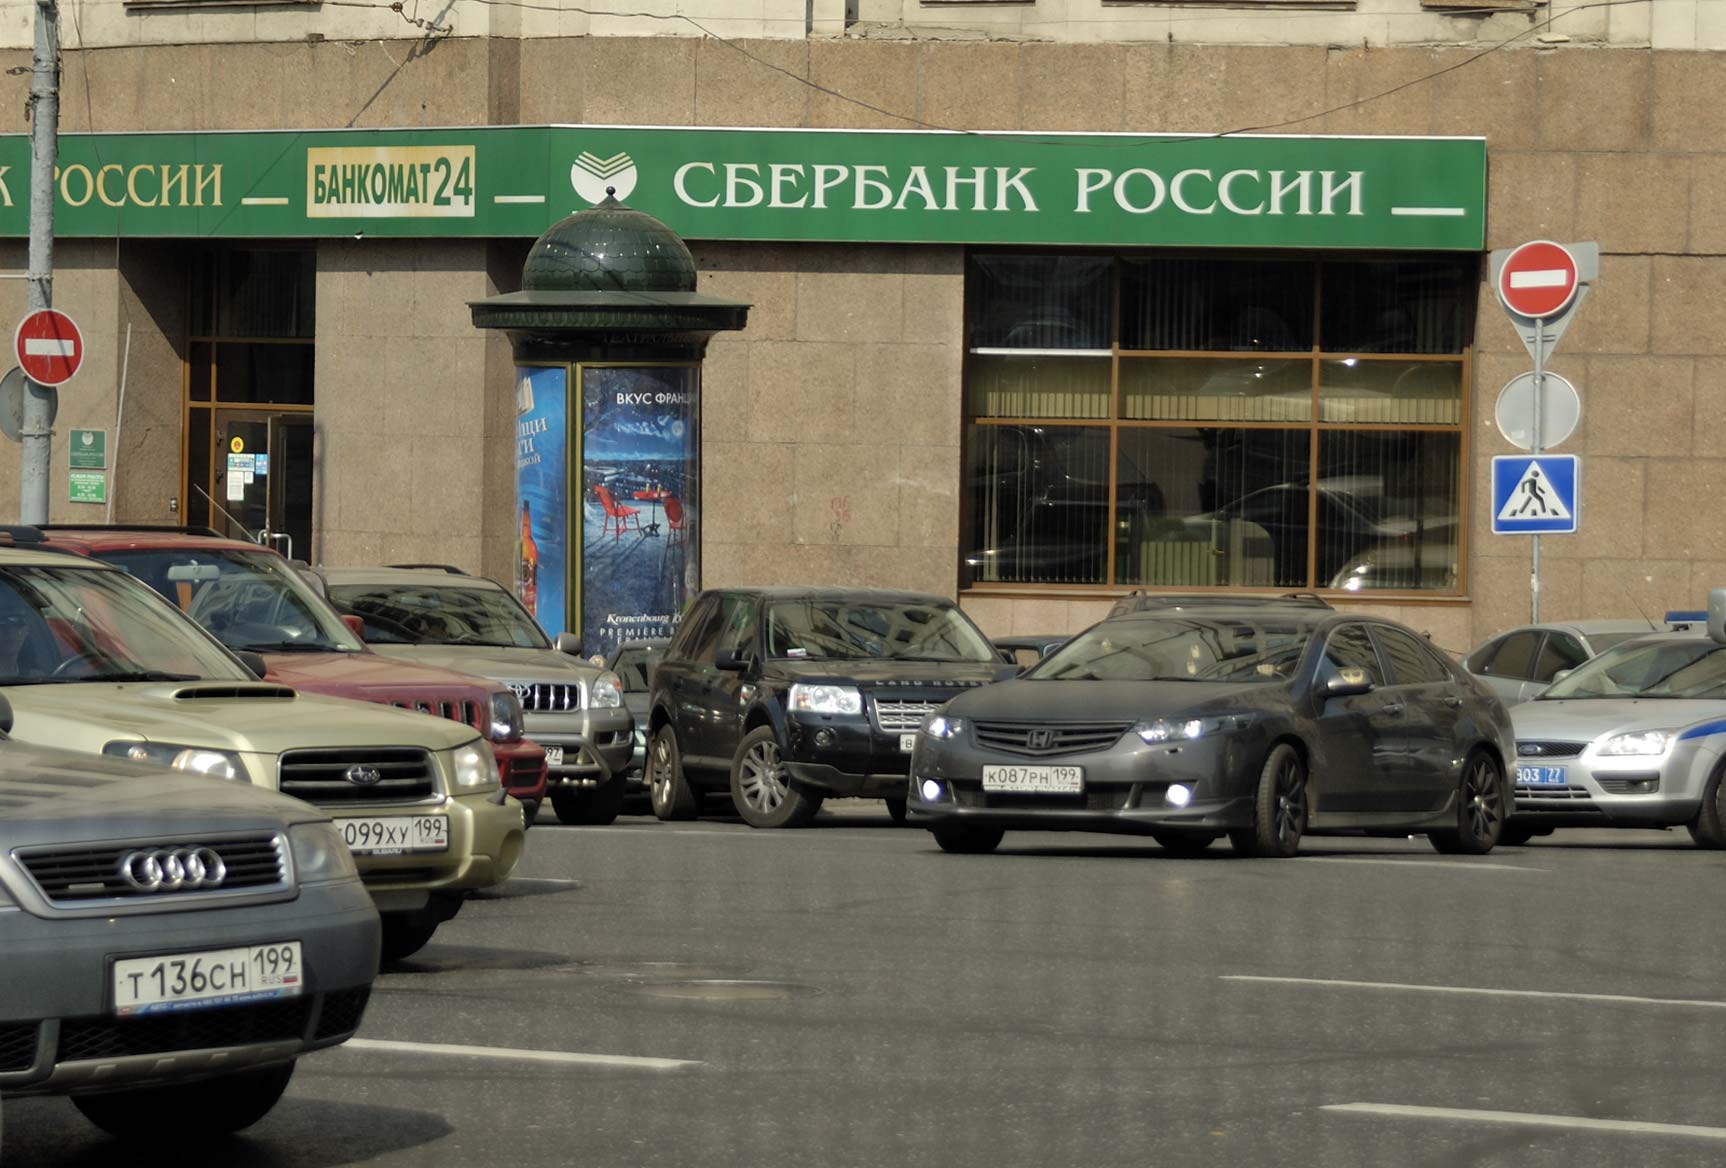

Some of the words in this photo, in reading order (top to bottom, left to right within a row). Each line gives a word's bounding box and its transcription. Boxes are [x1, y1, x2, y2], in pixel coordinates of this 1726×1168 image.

[673, 161, 1040, 212] СБЕРБАНК
[1073, 167, 1365, 216] РОССИИ
[616, 392, 652, 405] ВКУС
[988, 768, 1049, 784] К087РН
[1053, 768, 1077, 781] 199
[415, 818, 442, 837] 199
[127, 958, 246, 999] Т136СН
[253, 945, 294, 976] 199
